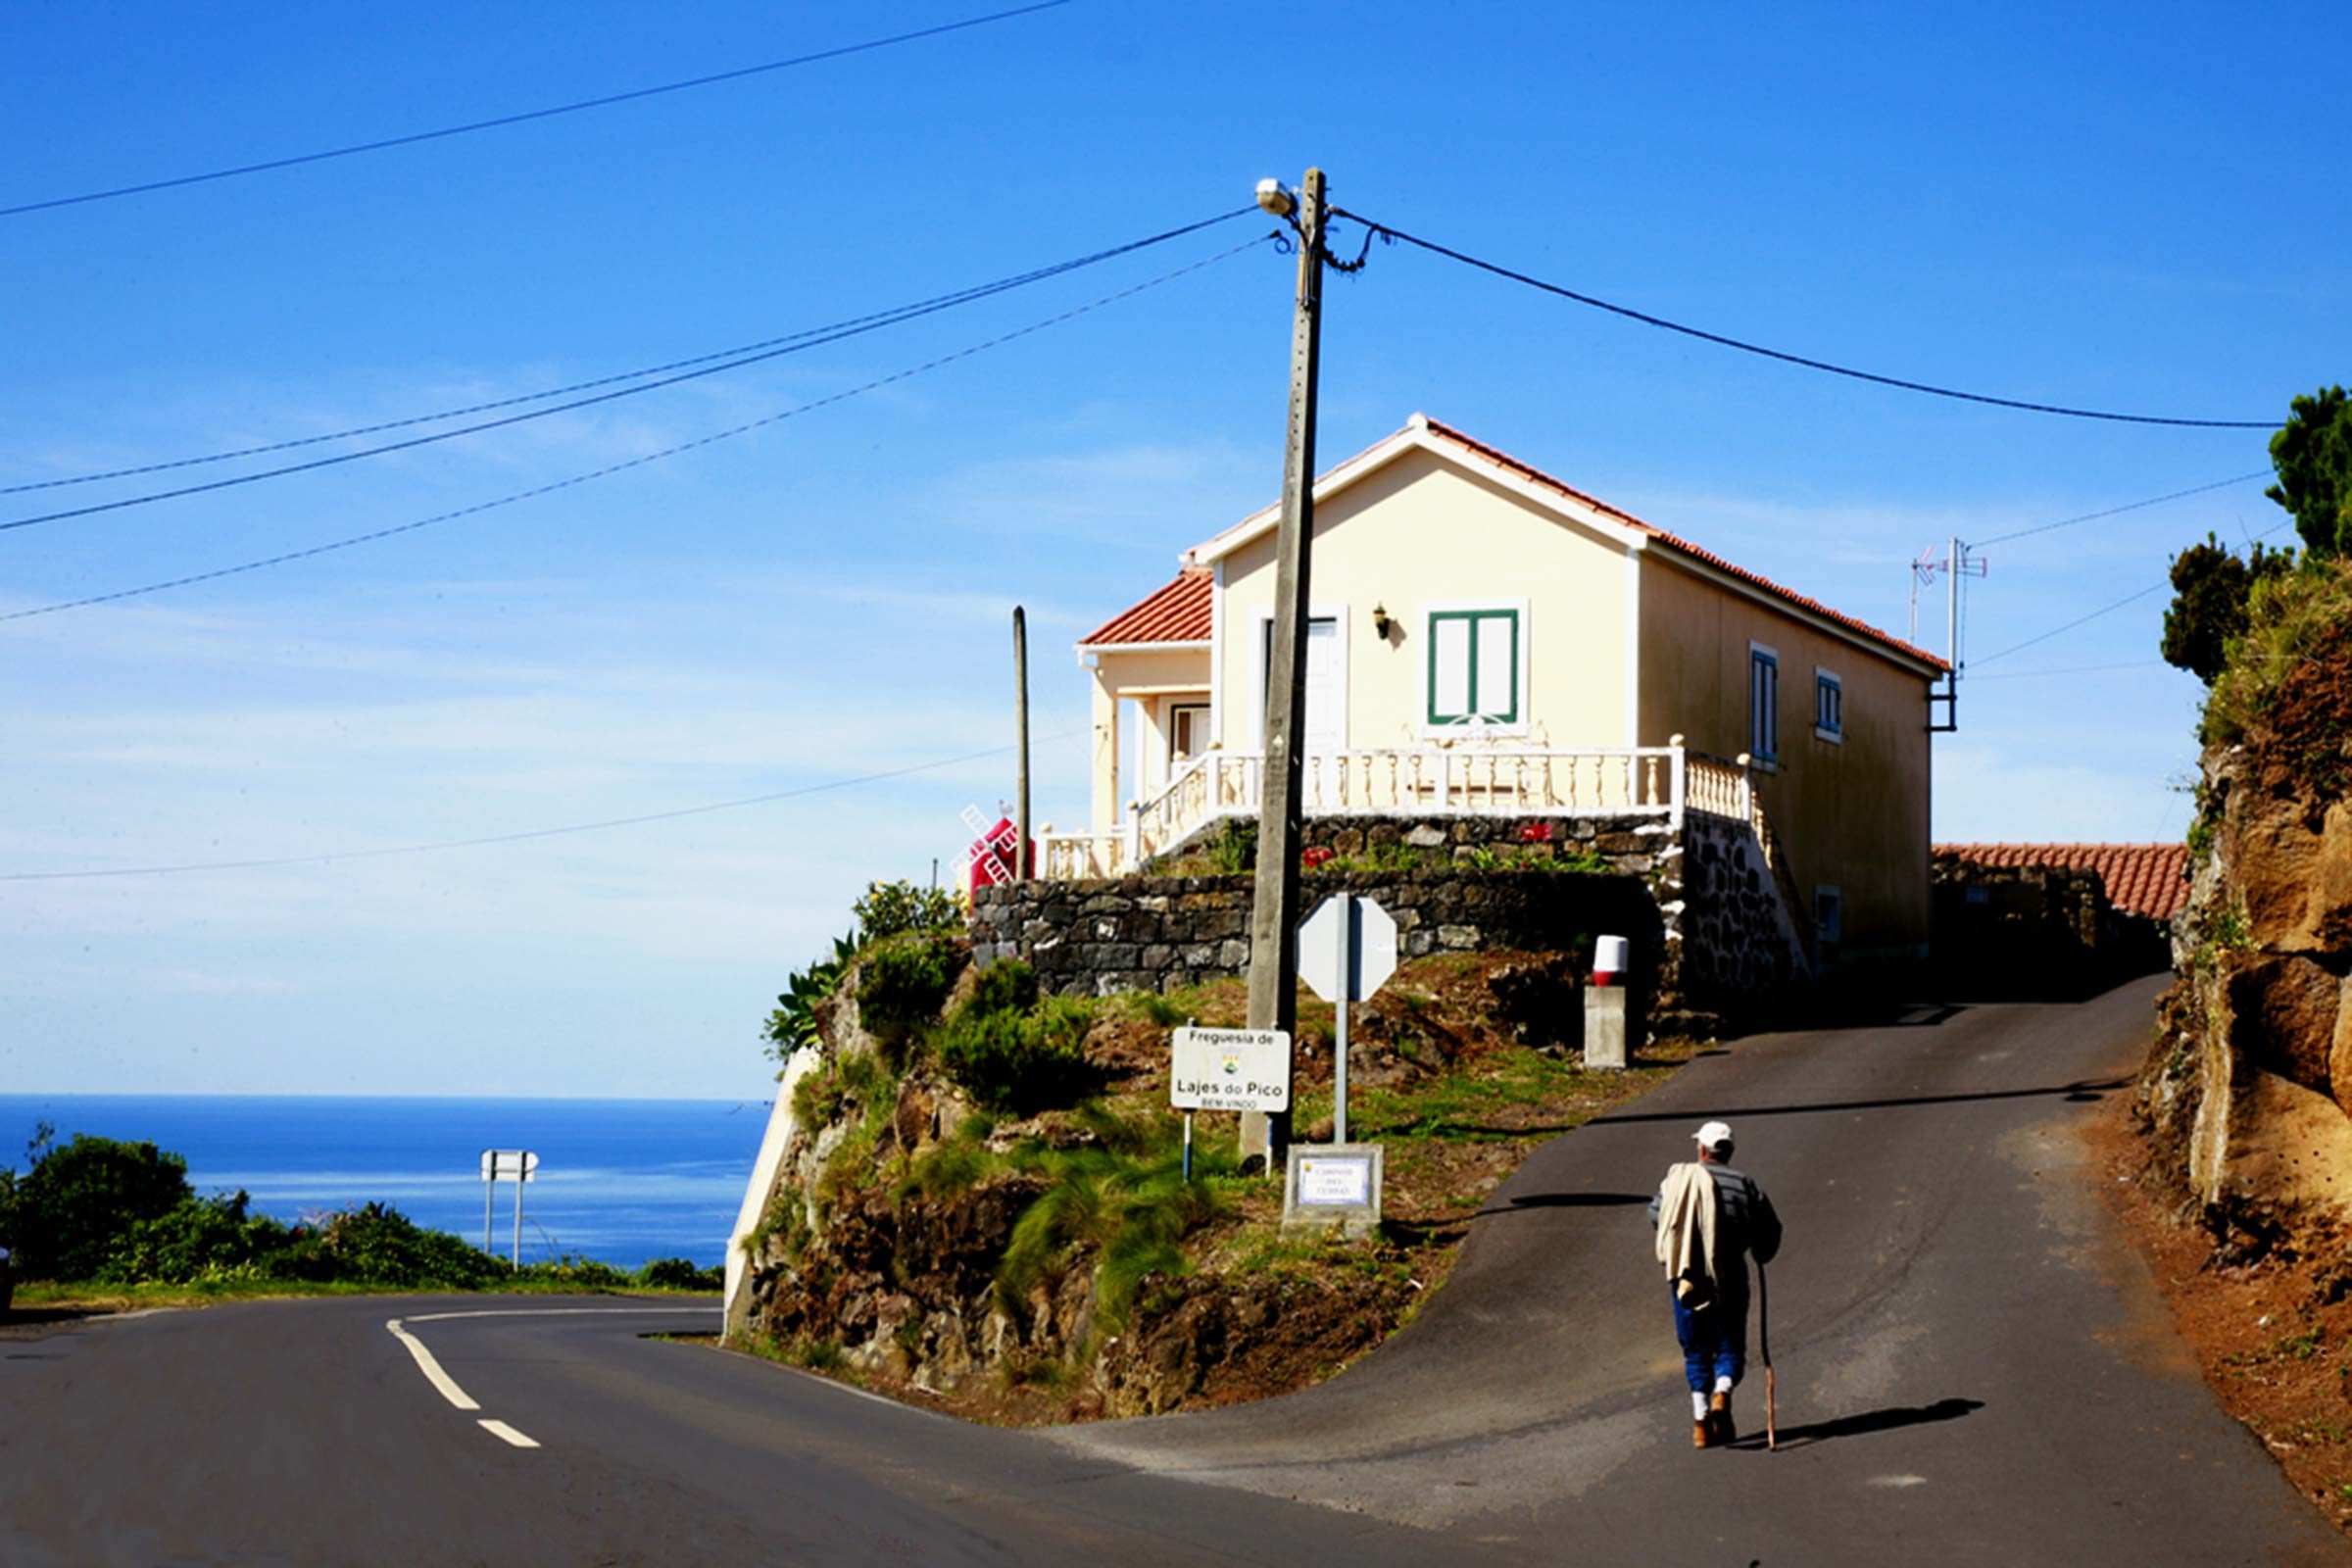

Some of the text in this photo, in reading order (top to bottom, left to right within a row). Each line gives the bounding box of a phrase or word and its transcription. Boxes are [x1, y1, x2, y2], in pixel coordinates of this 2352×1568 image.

[1190, 1030, 1274, 1044] Freguesia de
[1177, 1079, 1283, 1096] Lajes do Pico
